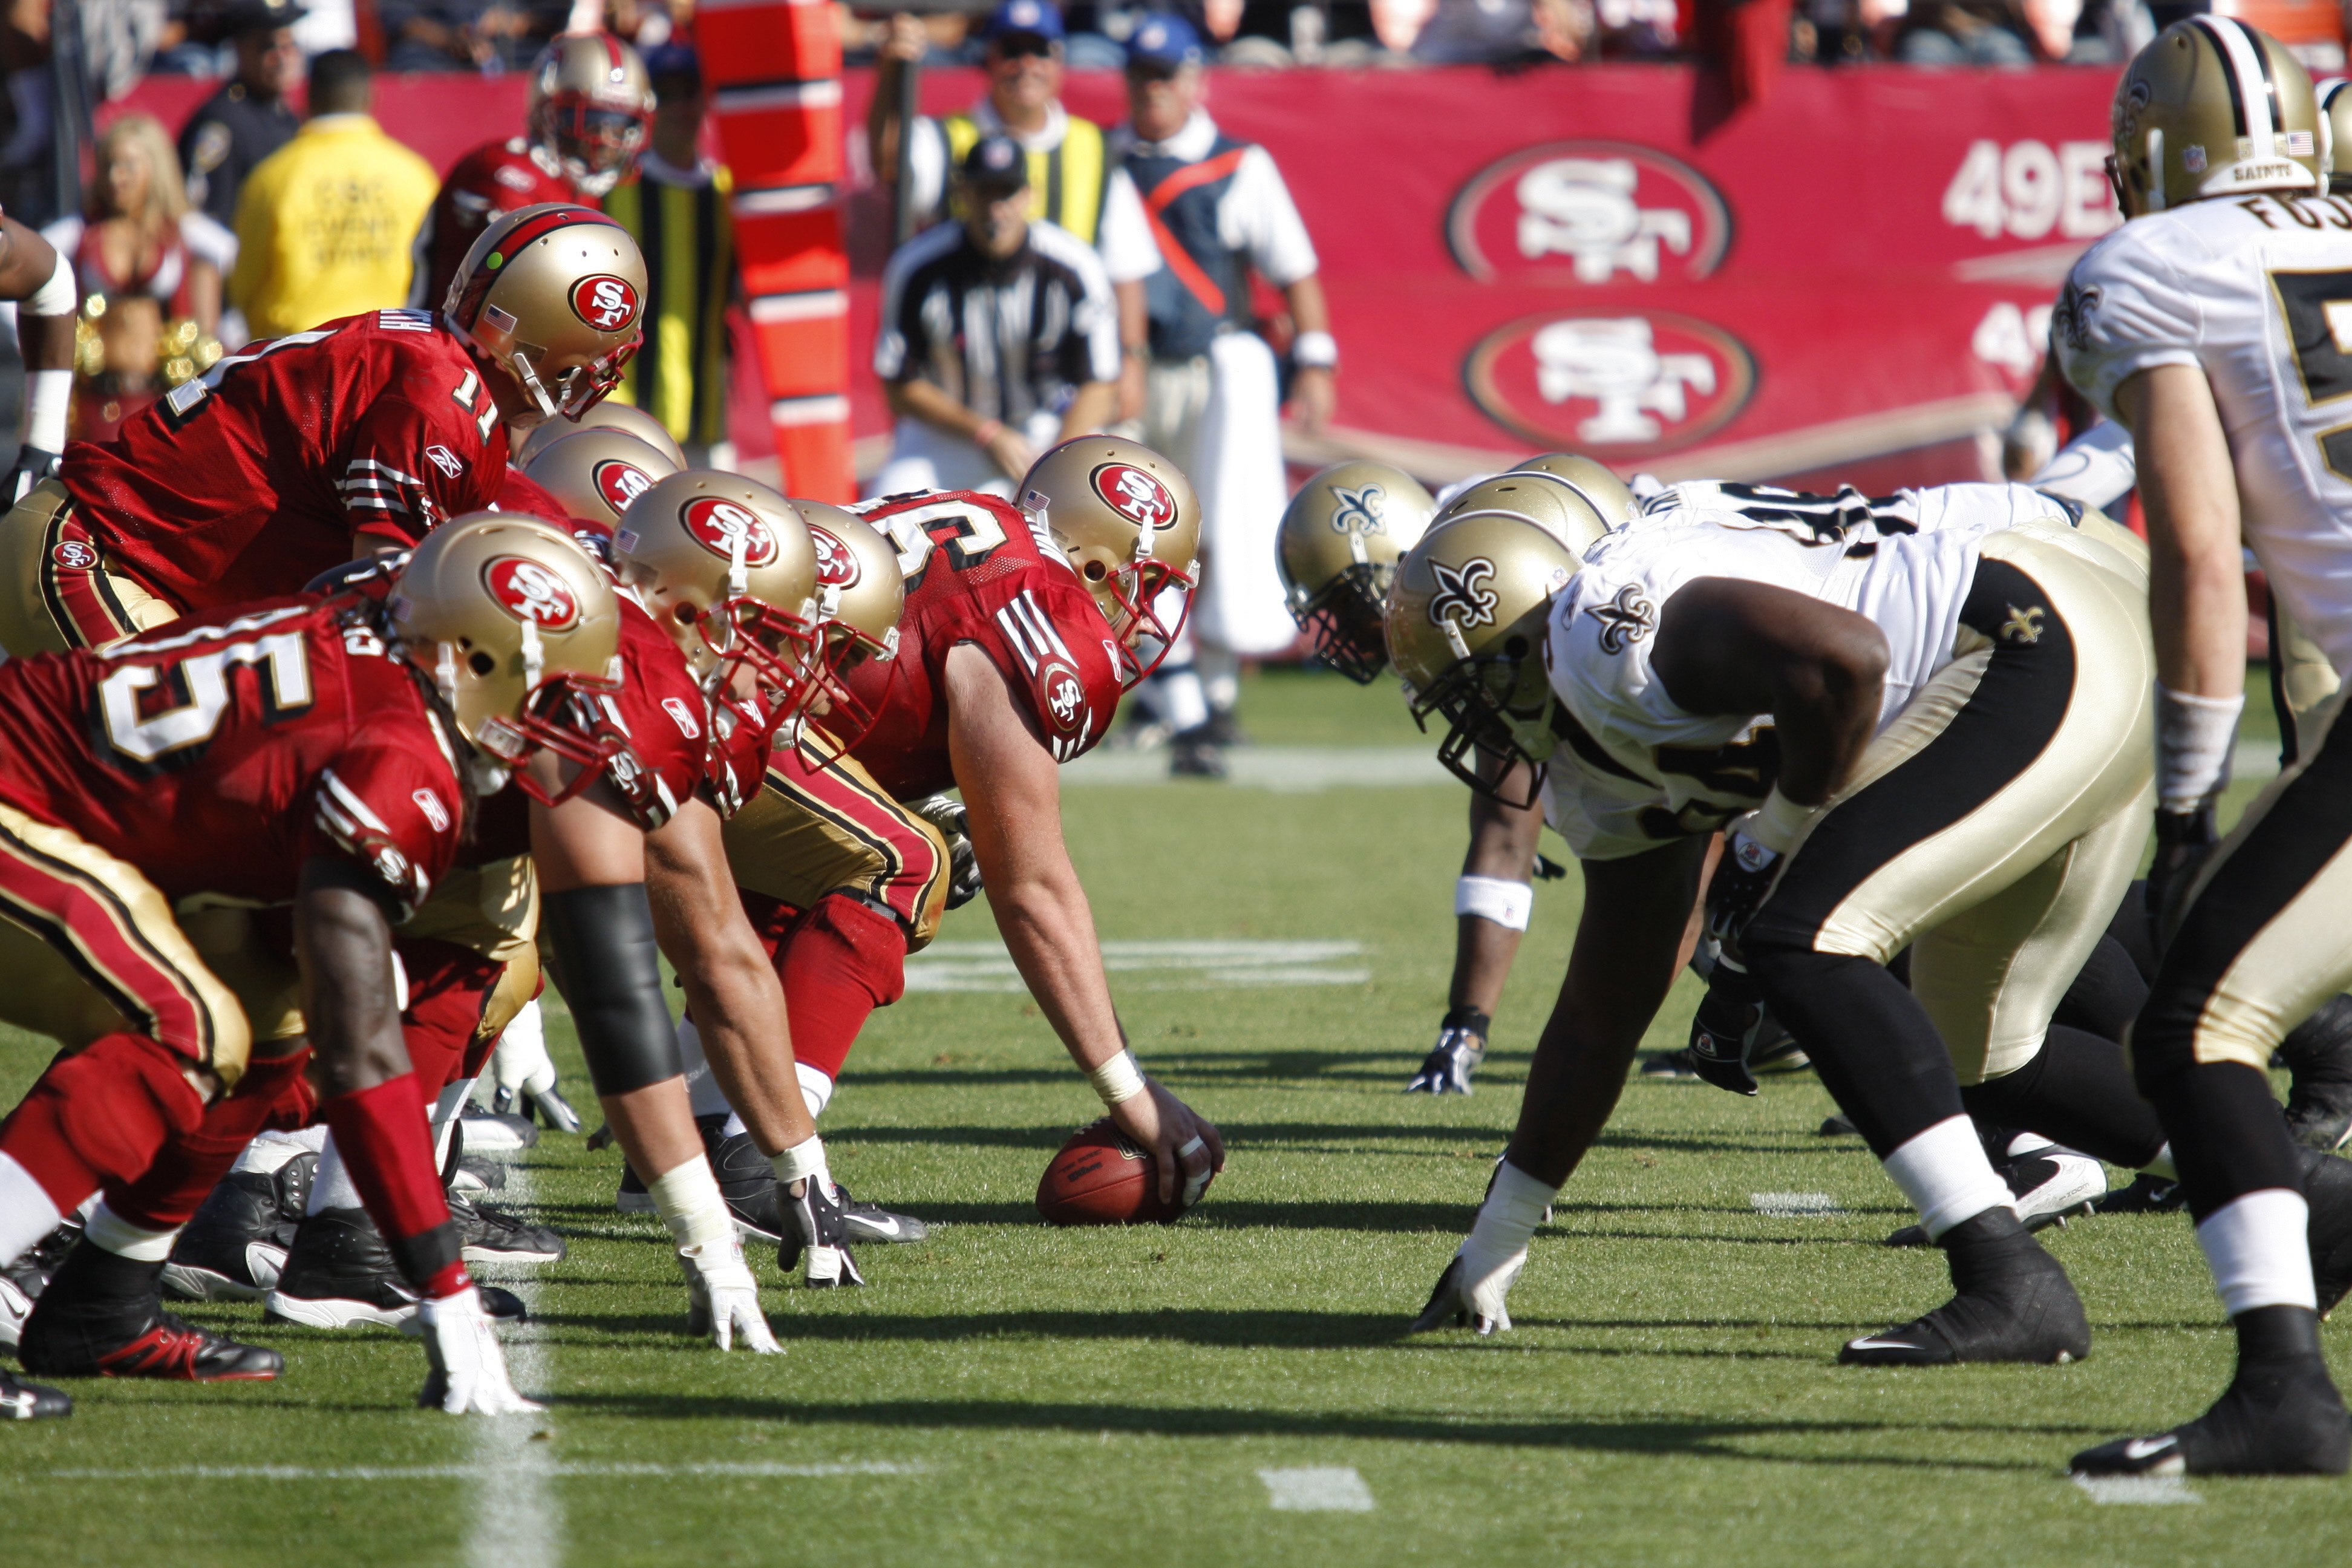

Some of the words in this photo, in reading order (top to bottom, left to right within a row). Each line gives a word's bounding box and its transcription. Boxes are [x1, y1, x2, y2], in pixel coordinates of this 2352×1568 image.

[2234, 163, 2293, 180] SAINTS
[1517, 158, 1691, 283] SF
[592, 281, 631, 327] SF
[1531, 316, 1716, 443] SF
[452, 368, 500, 442] 11
[1116, 471, 1166, 518] SF
[705, 503, 763, 555] SF
[62, 543, 91, 567] SF
[507, 563, 570, 621] SF
[1050, 679, 1082, 722] SF
